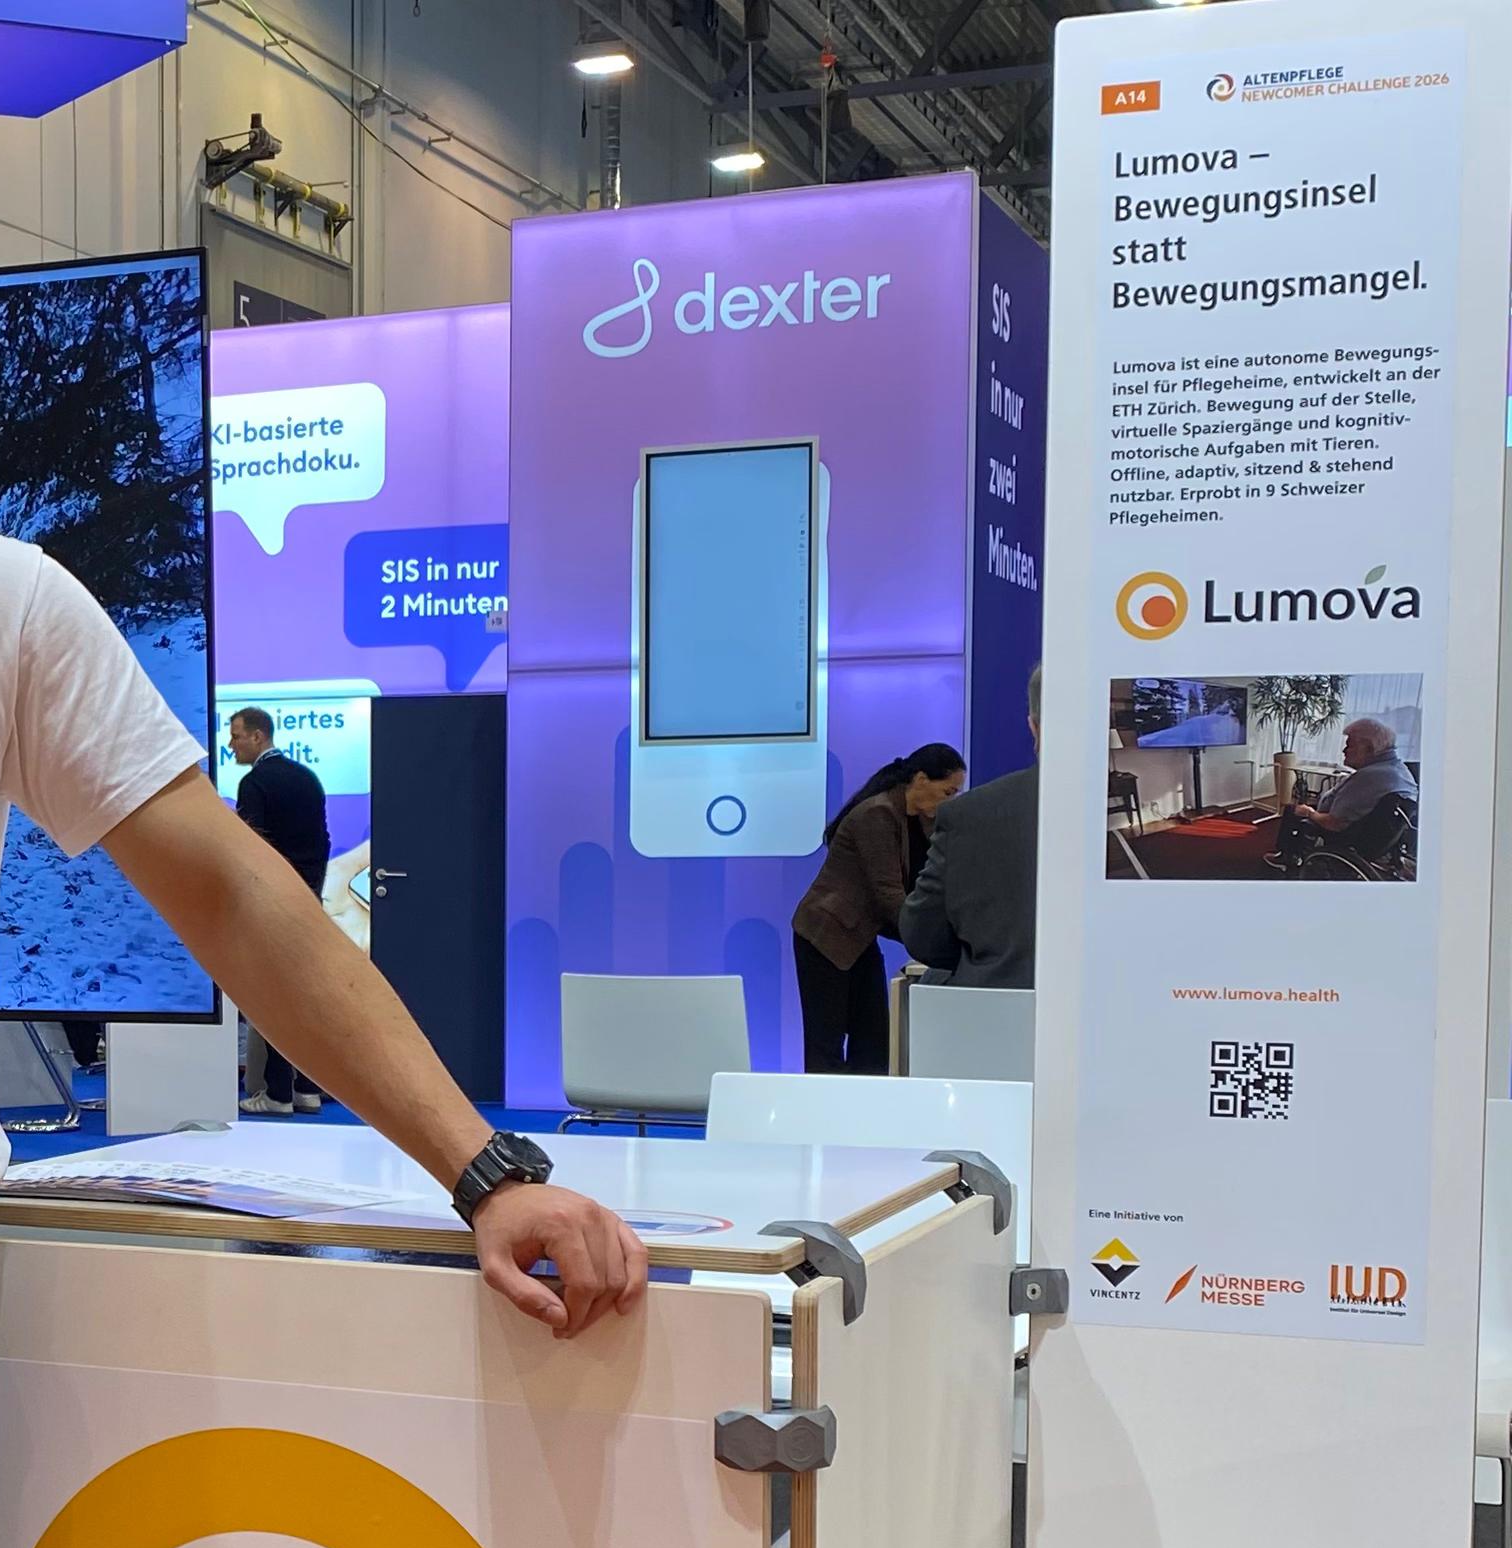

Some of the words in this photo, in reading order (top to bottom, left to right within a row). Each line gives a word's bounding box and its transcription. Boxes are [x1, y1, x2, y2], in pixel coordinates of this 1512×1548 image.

[1241, 83, 1324, 102] NEWCOMER
[1328, 75, 1411, 95] CHALLENGE
[1414, 73, 1450, 88] 2026
[1243, 67, 1344, 86] ALTENPFLEGE
[1115, 90, 1147, 106] A14
[1115, 147, 1238, 179] Lumova
[1114, 174, 1377, 222] Bewegungsinsel
[1111, 235, 1187, 266] statt
[1112, 260, 1428, 311] Bewegungsmangel.
[674, 270, 891, 335] dexter
[992, 283, 1011, 343] SIS
[1113, 361, 1176, 374] Lumova
[1181, 357, 1200, 371] ist
[1204, 355, 1240, 369] eine
[1244, 352, 1329, 367] autonome
[1334, 346, 1440, 363] Bewegungs-
[1112, 380, 1149, 396] insel
[1153, 380, 1178, 394] für
[1182, 374, 1288, 394] Pflegeheime,
[1293, 368, 1382, 386] entwickelt
[1386, 370, 1407, 381] an
[1412, 365, 1441, 380] der
[990, 360, 1002, 417] in
[1003, 386, 1024, 431] nur
[1112, 403, 1142, 418] ETH
[1147, 400, 1202, 416] Zürich.
[1206, 398, 1294, 414] Bewegung
[1299, 392, 1328, 408] auf
[1331, 392, 1360, 406] der
[1364, 389, 1416, 405] Stelle,
[212, 416, 344, 445] KI-basierte
[1111, 422, 1178, 439] virtuelle
[1182, 418, 1293, 439] Spaziergänge
[1298, 414, 1330, 430] und
[1335, 412, 1411, 431] kognitiv-
[1111, 443, 1200, 460] motorische
[1204, 440, 1285, 459] Aufgaben
[1290, 438, 1318, 452] mit
[1322, 436, 1379, 451] Tieren.
[212, 448, 360, 484] Sprachdoku.
[989, 454, 1016, 505] zwei
[1110, 467, 1170, 482] Offline,
[1175, 464, 1240, 481] adaptiv,
[1244, 460, 1303, 476] sitzend
[1308, 460, 1321, 473] &
[1326, 456, 1393, 473] stehend
[1110, 488, 1175, 504] nutzbar.
[1180, 484, 1241, 503] Erprobt
[1246, 484, 1260, 498] in
[1266, 484, 1275, 497] 9
[1280, 480, 1366, 497] Schweizer
[1110, 508, 1224, 527] Pflegeheimen.
[381, 559, 420, 584] SIS
[426, 556, 449, 581] in
[457, 560, 500, 580] nur
[988, 523, 1037, 592] Minuten.
[381, 595, 396, 619] 2
[403, 592, 508, 617] Minuten
[1204, 580, 1421, 623] Lumova
[1172, 987, 1340, 1003] www.lumova.health
[1088, 1209, 1111, 1219] Eine
[1113, 1210, 1161, 1222] Initiative
[1163, 1214, 1184, 1222] von
[1090, 1289, 1141, 1300] VINCENTZ
[1201, 1273, 1305, 1293] NÜRNBERG
[1330, 1264, 1407, 1302] IUD
[1201, 1291, 1265, 1306] MESSE
